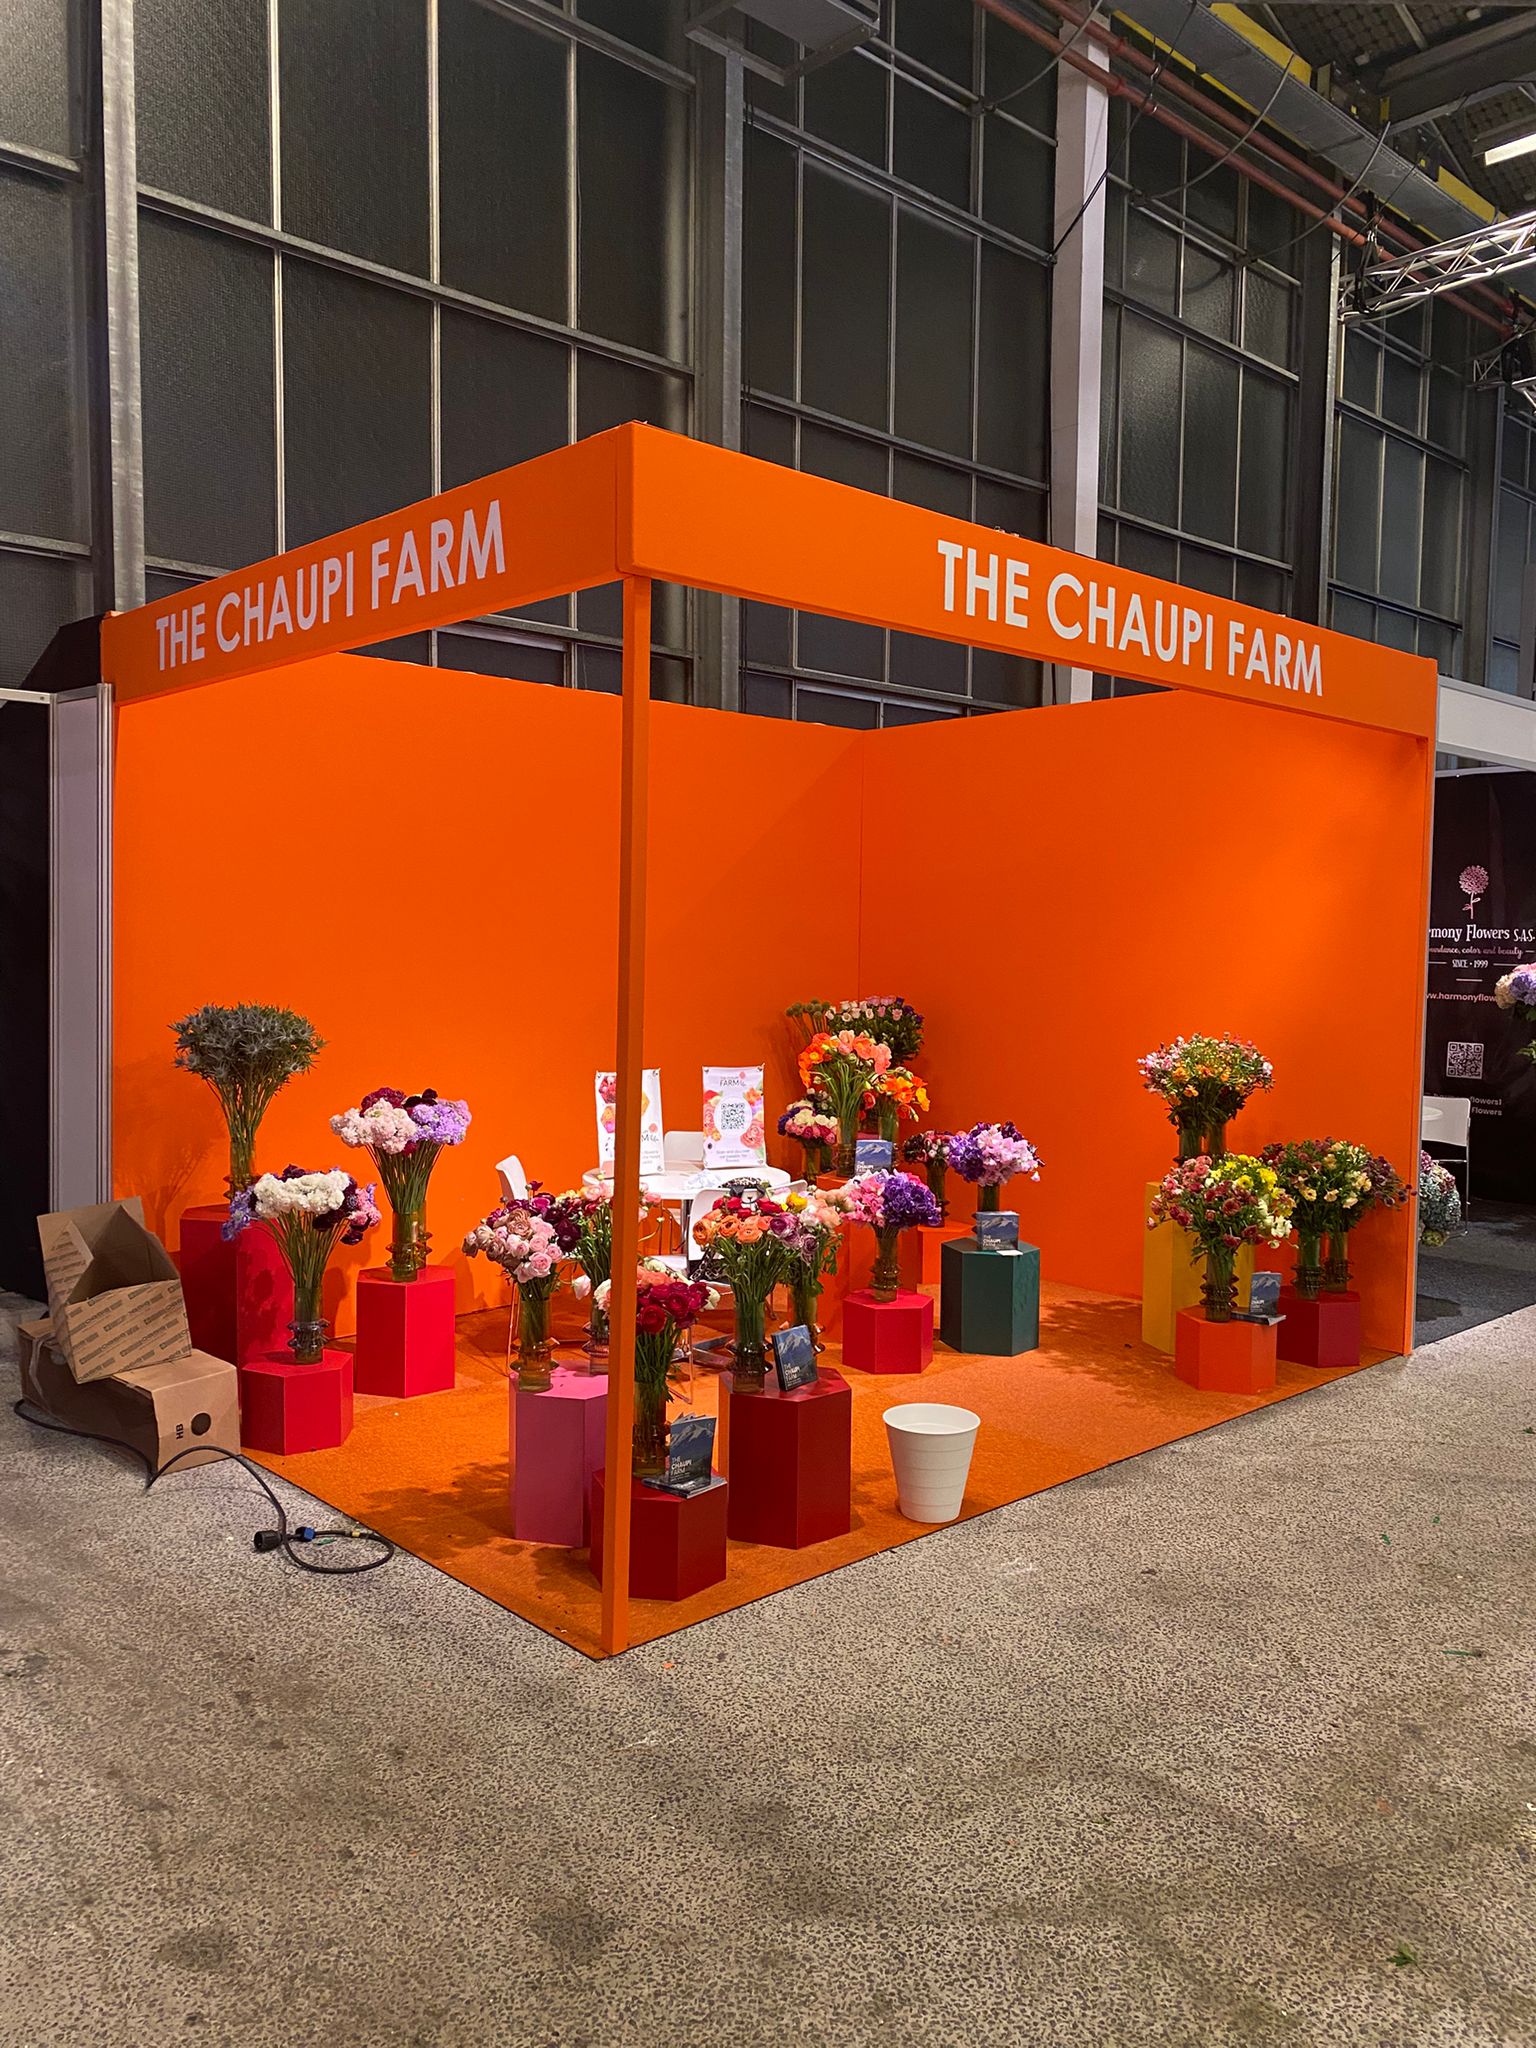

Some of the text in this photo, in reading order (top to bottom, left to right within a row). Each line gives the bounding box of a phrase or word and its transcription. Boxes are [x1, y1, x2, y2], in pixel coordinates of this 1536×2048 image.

[156, 500, 505, 671] THE CHAUPI FARM
[937, 540, 1323, 697] THE CHAUPI FARM
[1466, 924, 1510, 942] Flowers
[1452, 959, 1488, 968] SINCE 1999
[176, 1423, 184, 1440] HB
